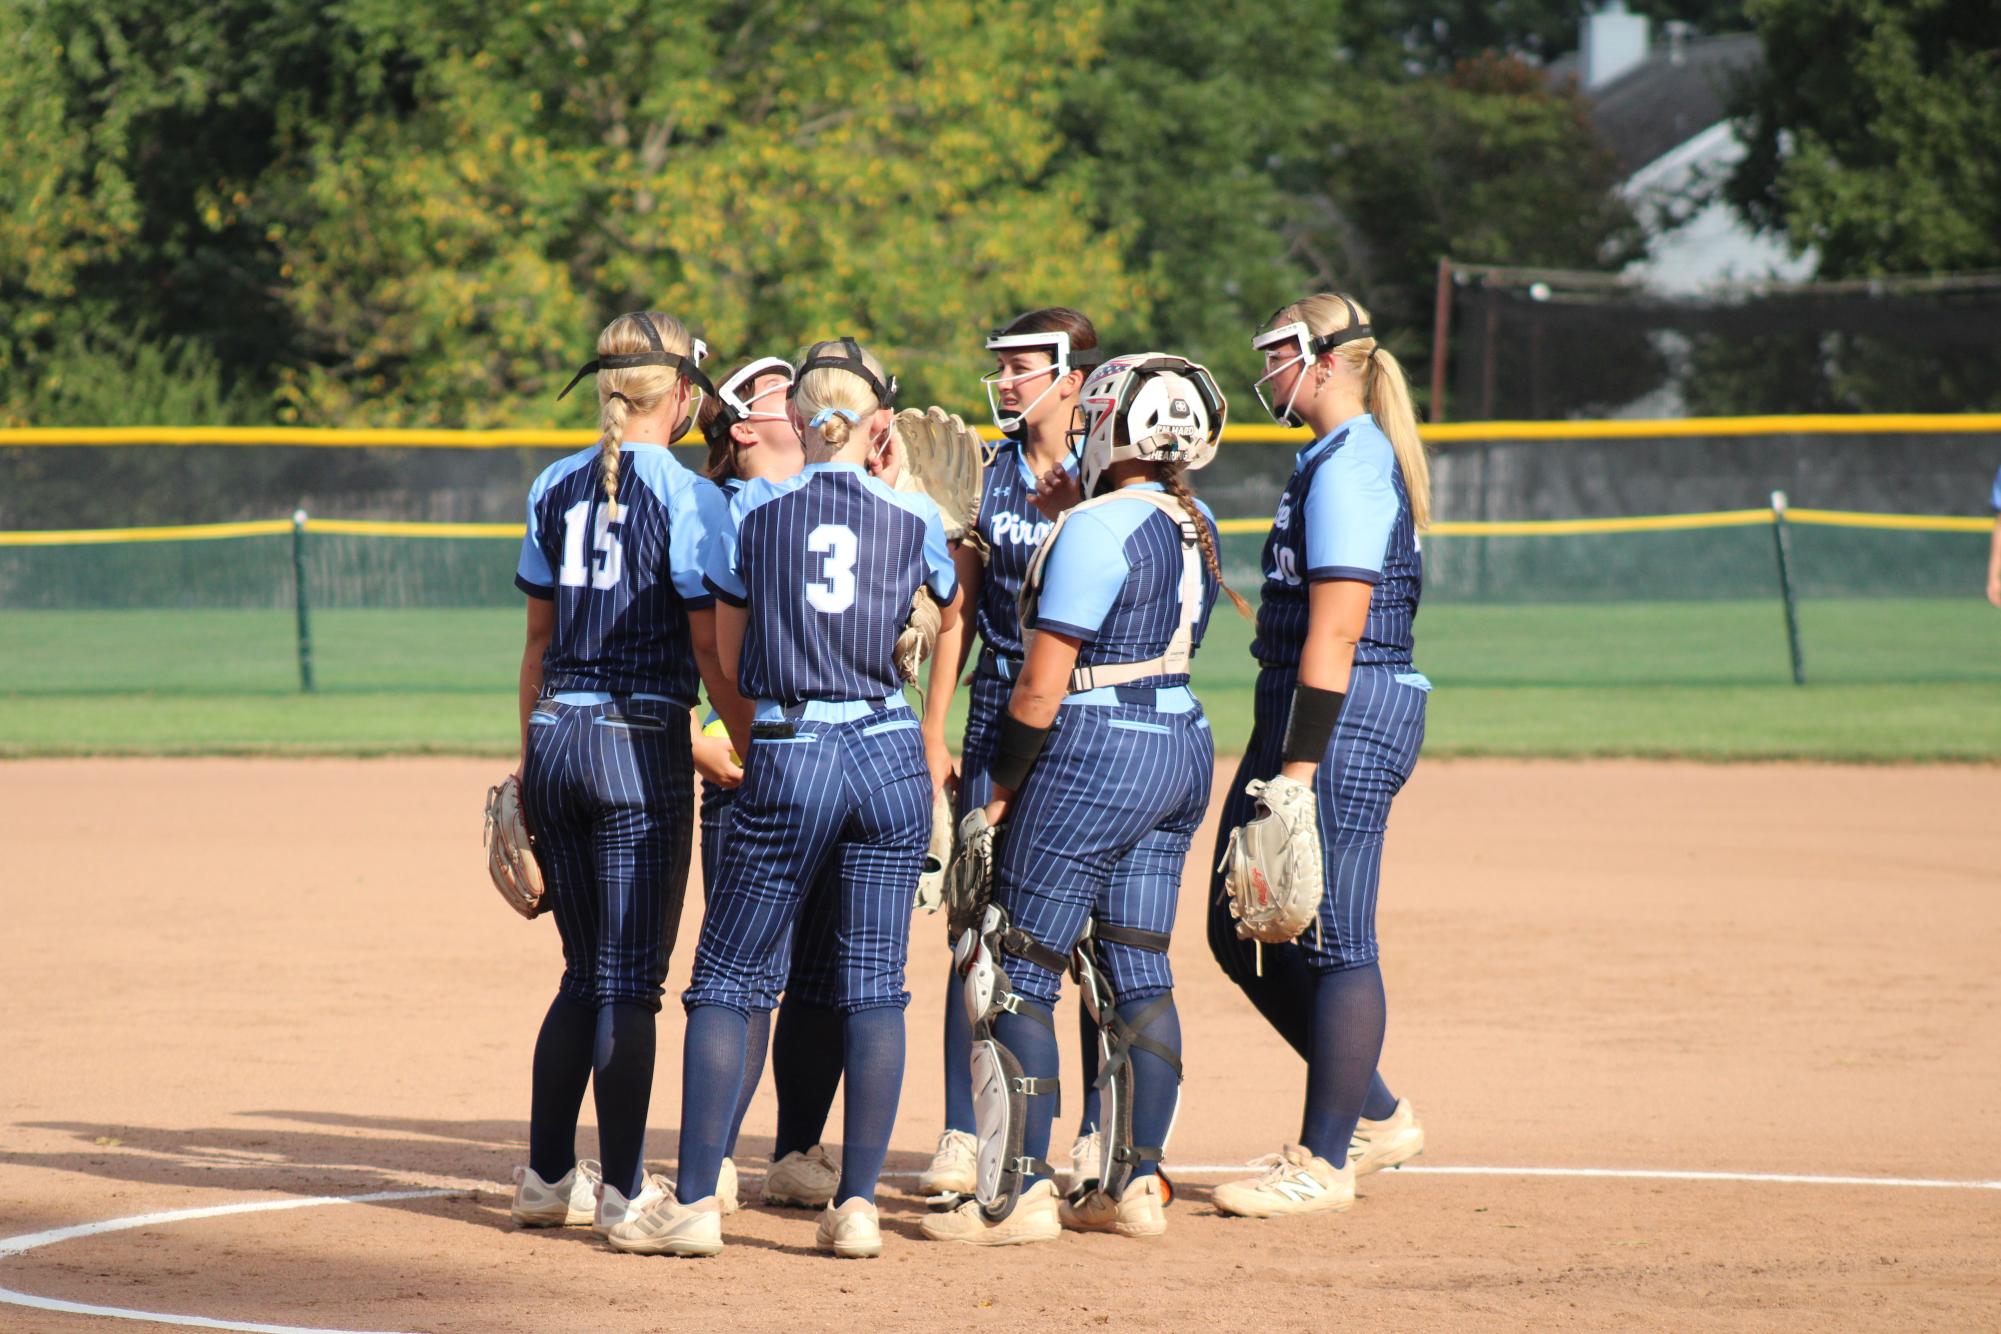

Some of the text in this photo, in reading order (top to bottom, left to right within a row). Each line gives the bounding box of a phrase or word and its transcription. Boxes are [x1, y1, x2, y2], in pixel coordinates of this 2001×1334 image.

[1171, 425, 1194, 436] HARD
[559, 500, 629, 591] 15
[991, 511, 1056, 547] Pira
[805, 523, 858, 614] 3
[1267, 543, 1303, 586] 10
